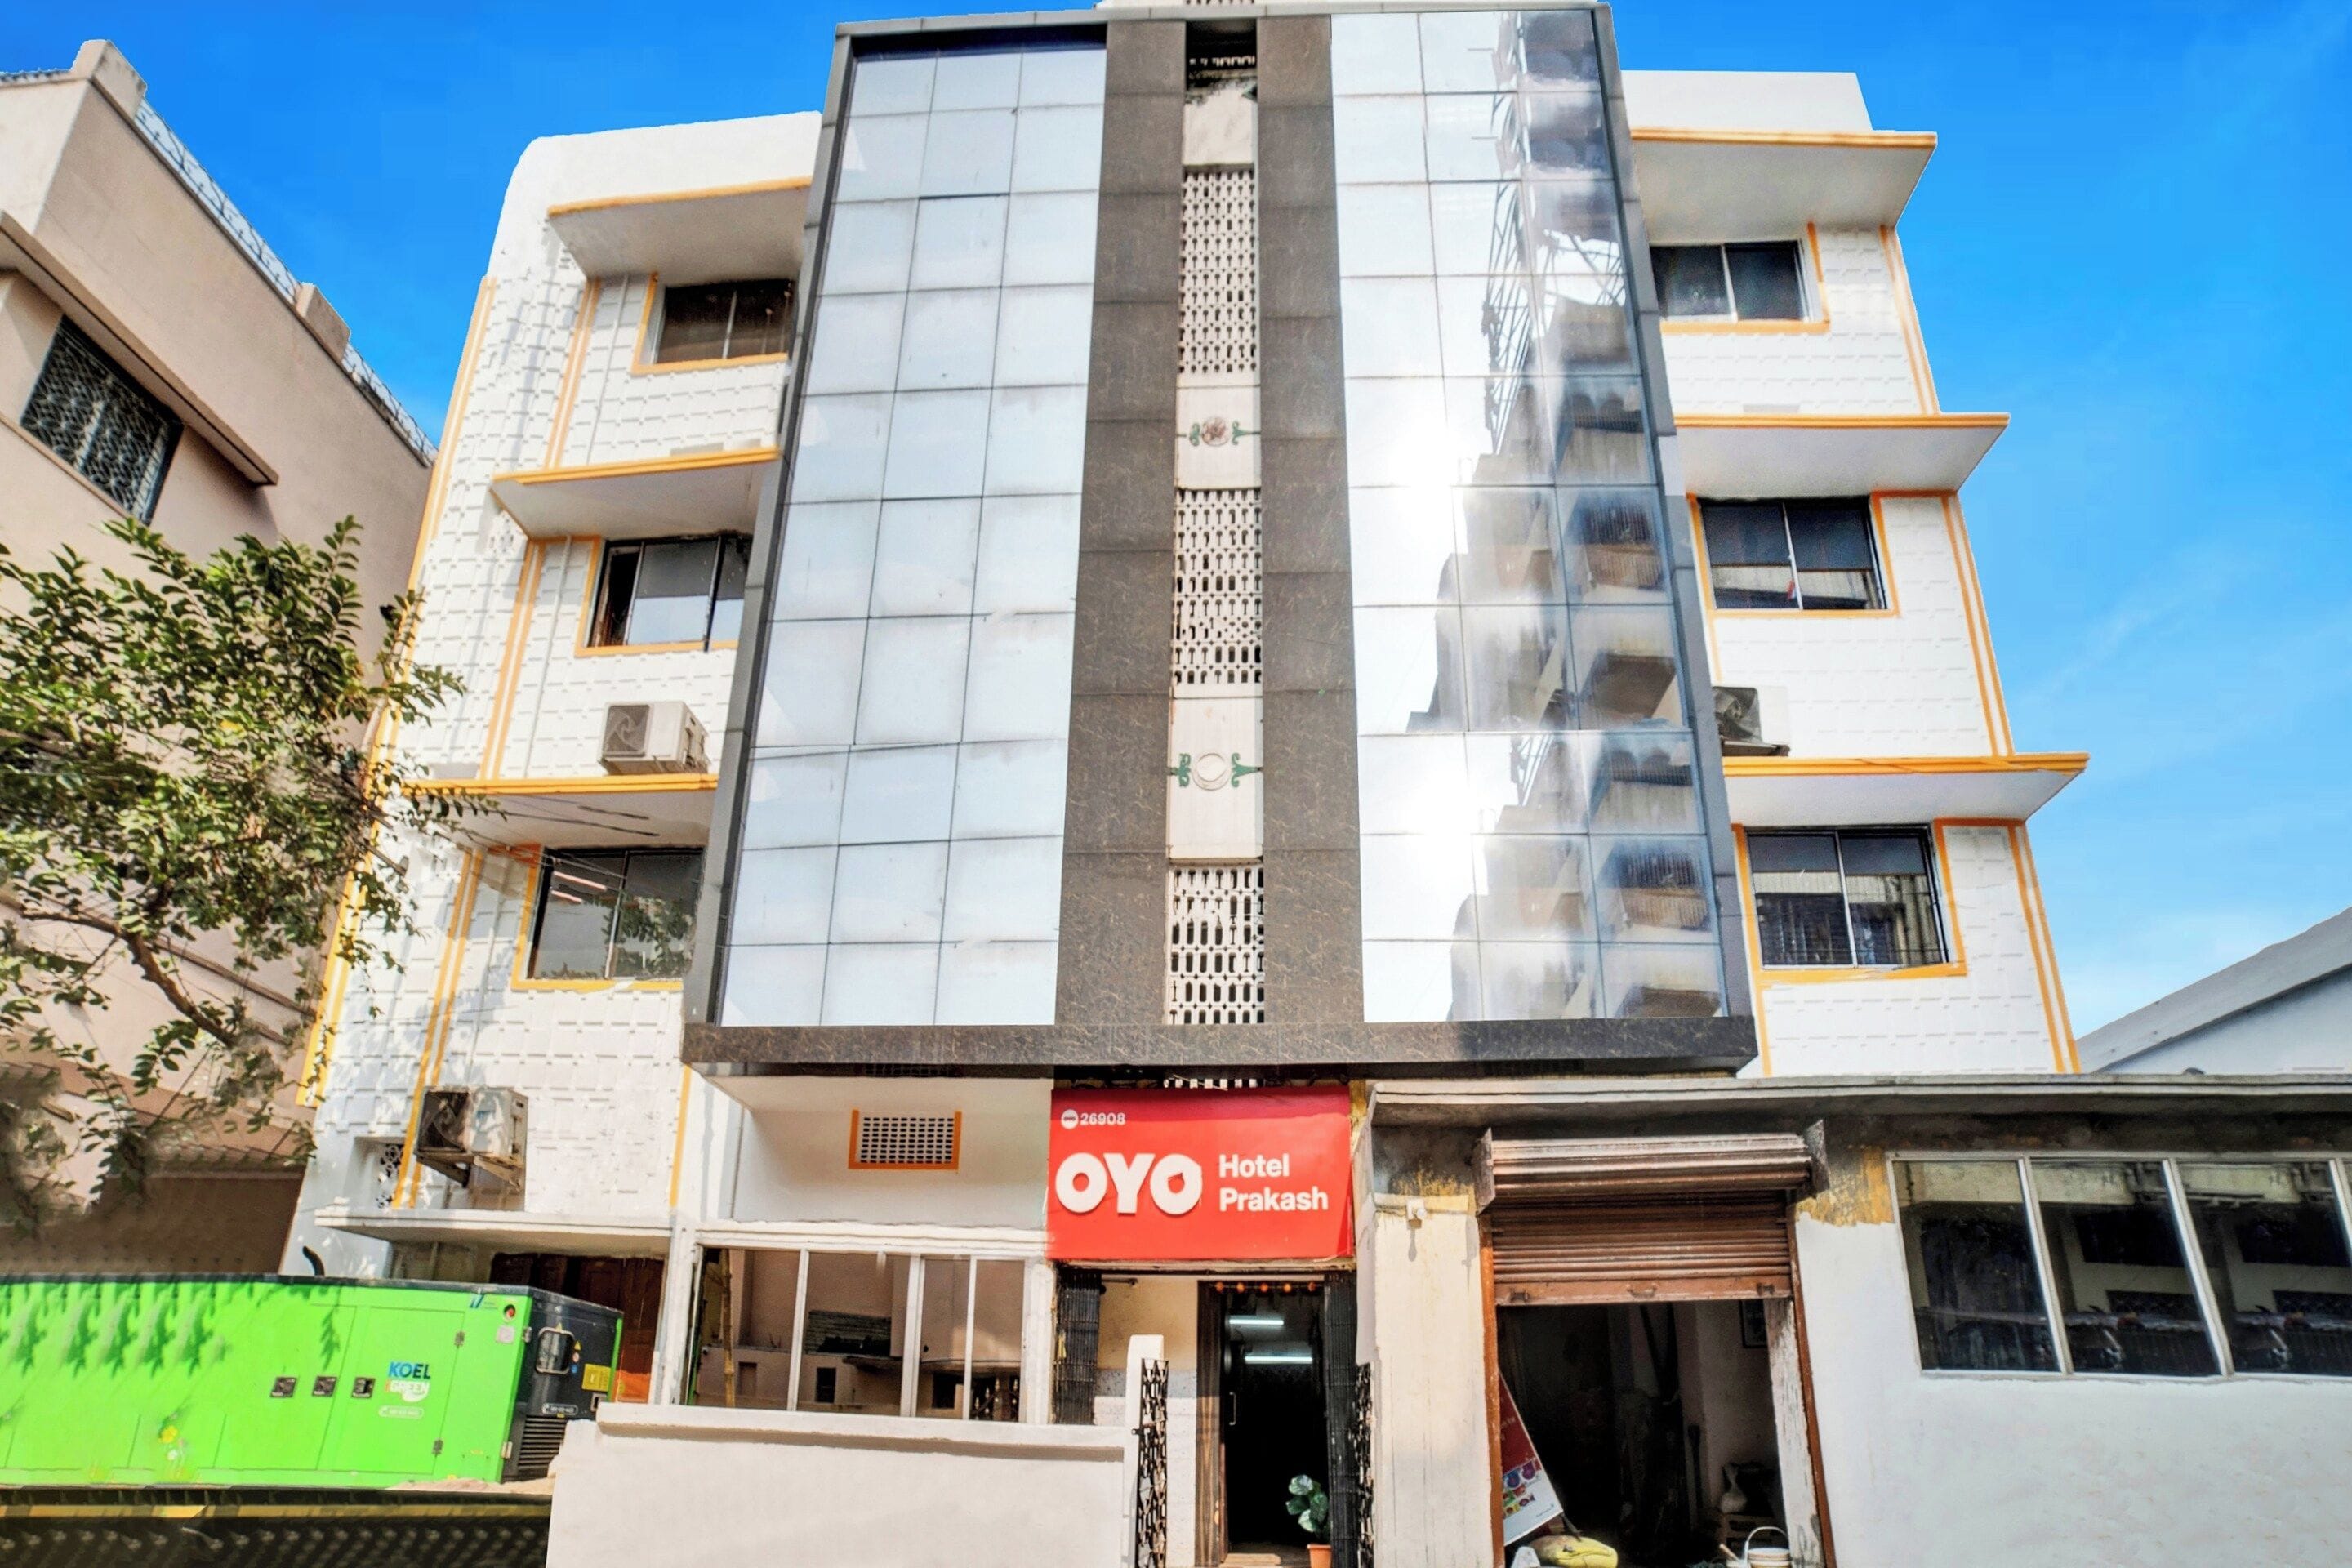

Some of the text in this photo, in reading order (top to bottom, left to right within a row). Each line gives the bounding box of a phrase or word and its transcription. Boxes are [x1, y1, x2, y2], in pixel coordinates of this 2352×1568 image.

[1080, 1112, 1126, 1126] 26908
[1219, 1153, 1289, 1178] Hotel
[1055, 1152, 1203, 1215] OYO
[1219, 1186, 1329, 1212] Prakash
[389, 1361, 431, 1379] KOEL
